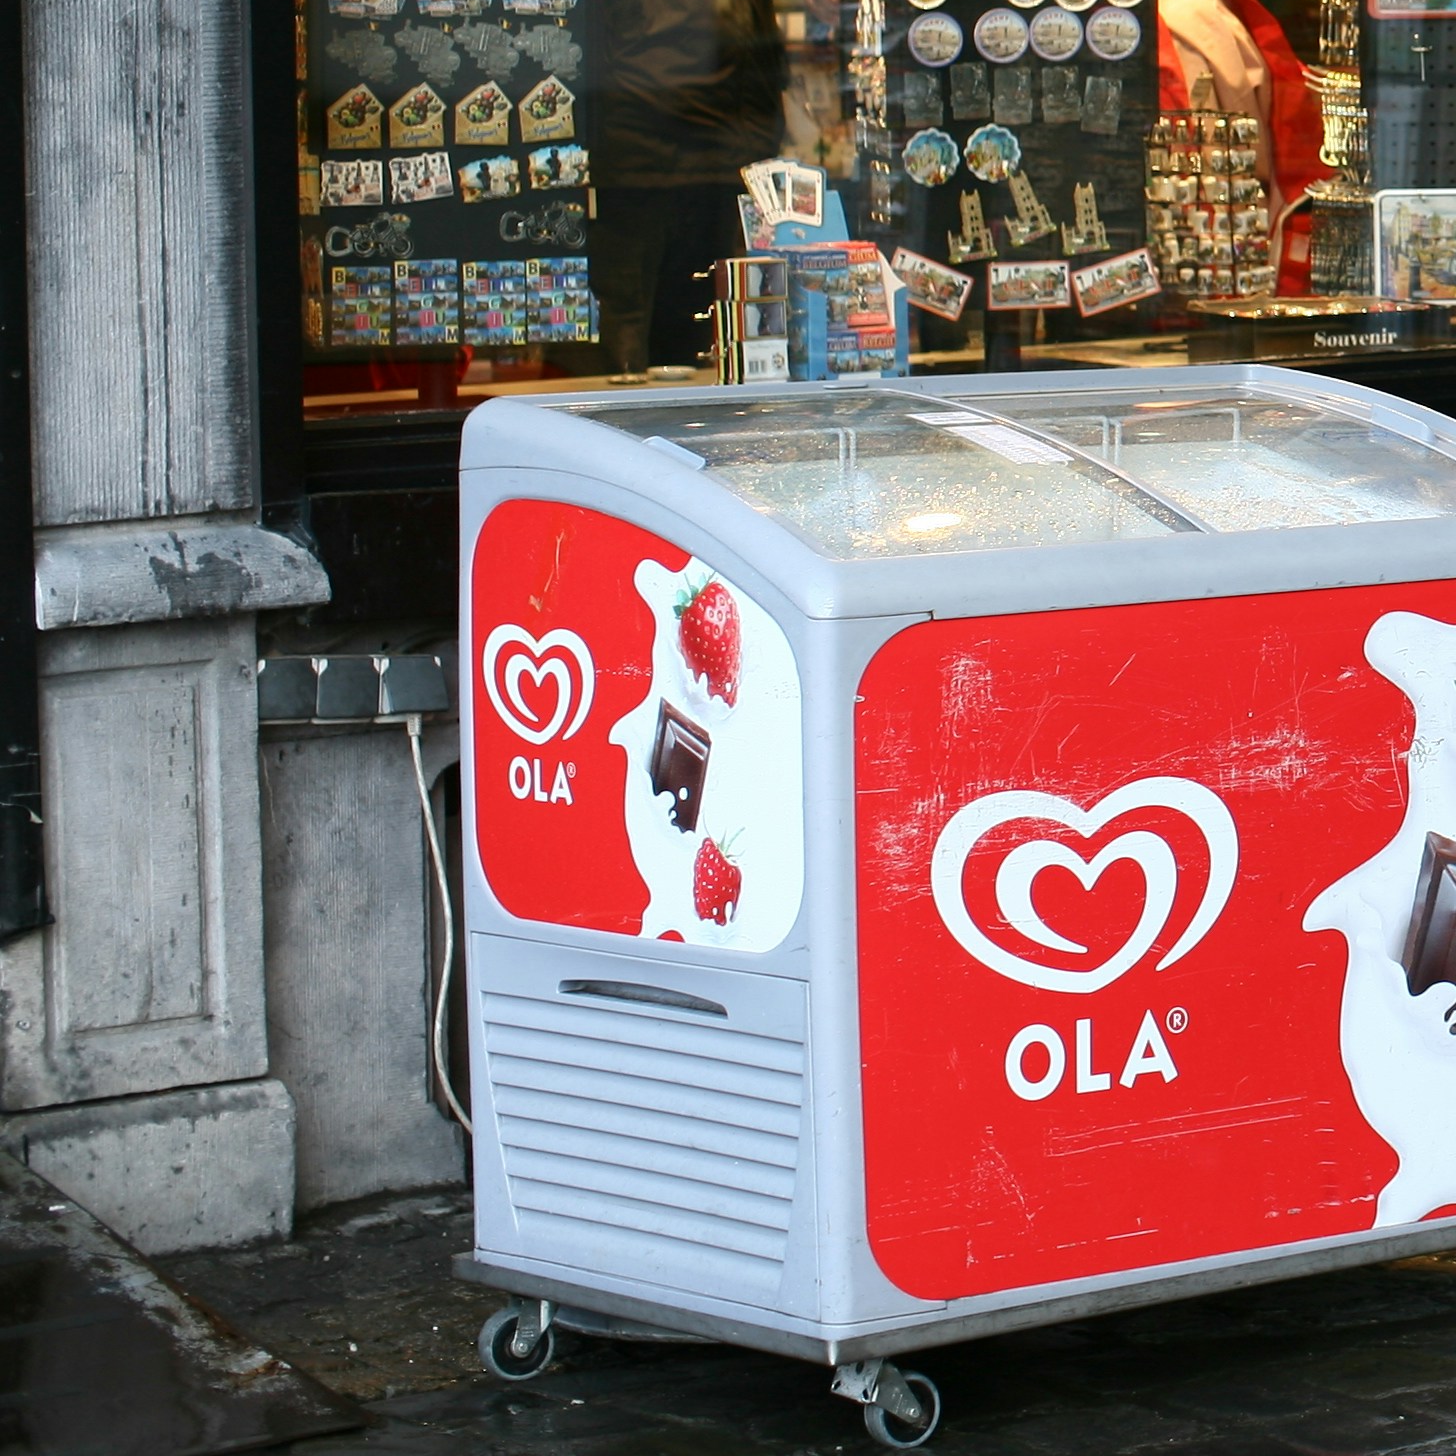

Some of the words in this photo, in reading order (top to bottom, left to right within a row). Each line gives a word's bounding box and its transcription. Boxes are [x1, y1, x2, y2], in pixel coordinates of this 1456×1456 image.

[1313, 328, 1398, 348] Souvenir
[507, 755, 573, 807] OLA
[1004, 1009, 1179, 1103] OLA
